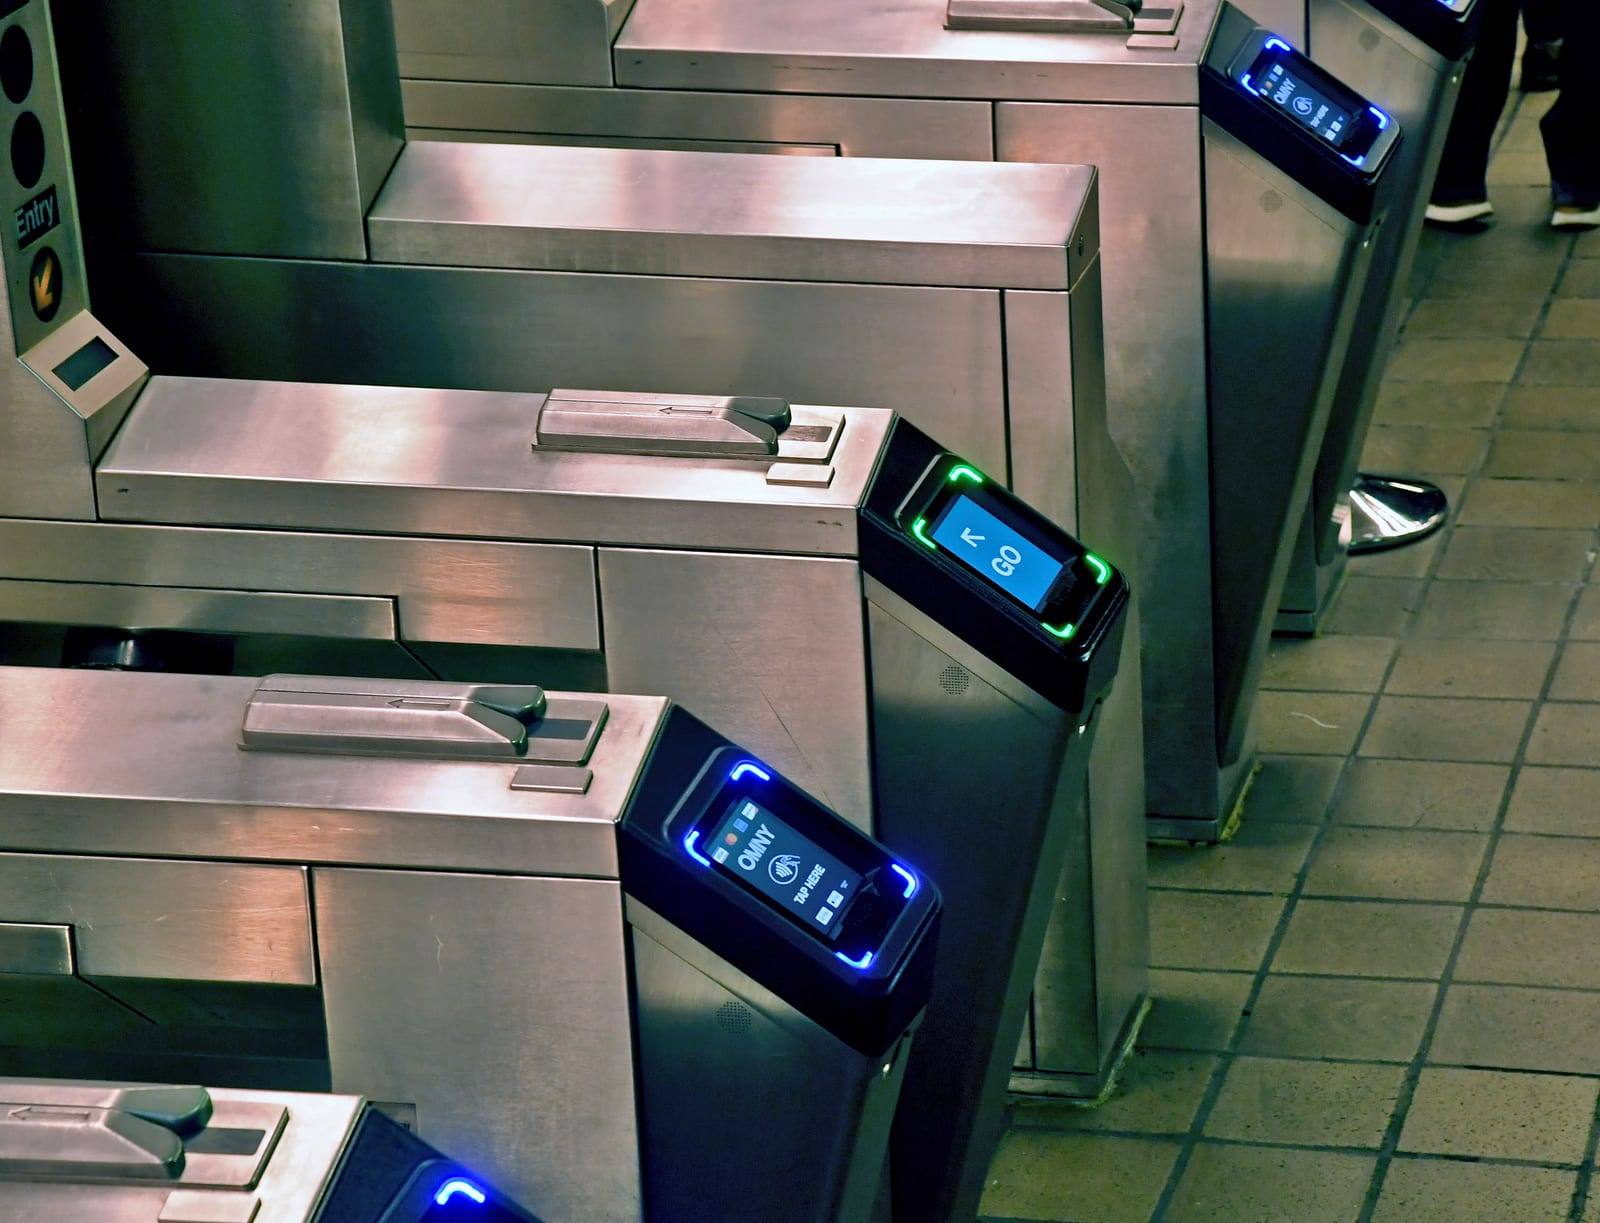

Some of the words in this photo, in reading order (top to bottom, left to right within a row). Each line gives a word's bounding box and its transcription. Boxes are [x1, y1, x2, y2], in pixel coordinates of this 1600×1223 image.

[1273, 77, 1297, 105] OMNY
[15, 194, 54, 240] Entry
[991, 545, 1022, 577] GO
[737, 823, 776, 871] OMNY
[793, 886, 810, 905] TAP
[804, 863, 826, 890] HERE
